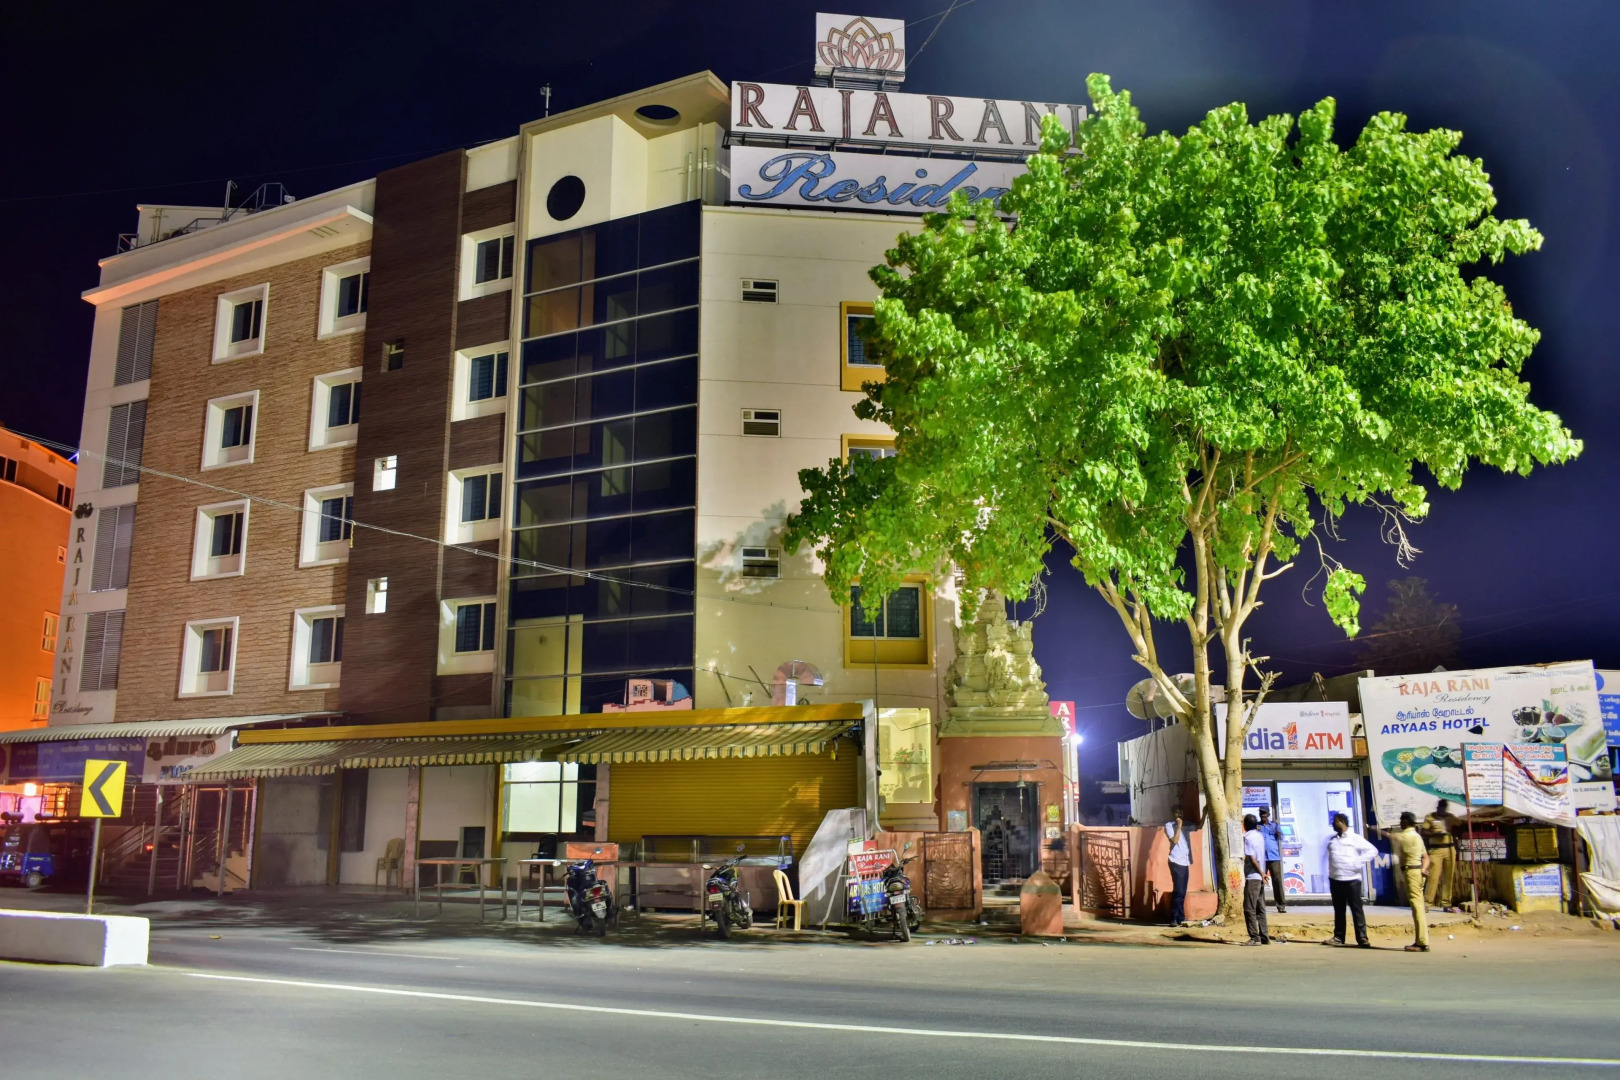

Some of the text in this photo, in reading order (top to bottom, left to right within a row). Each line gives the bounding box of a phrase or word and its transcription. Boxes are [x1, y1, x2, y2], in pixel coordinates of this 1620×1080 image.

[736, 82, 1086, 149] RAJA RANI
[738, 152, 1012, 210] Residen
[60, 527, 85, 695] RAJA RANI
[1399, 678, 1491, 697] RAJA RANI
[1433, 693, 1491, 704] Residency
[1381, 717, 1490, 735] ARYAAS HOTEL
[1304, 732, 1344, 750] ATM
[856, 855, 873, 863] RAJA
